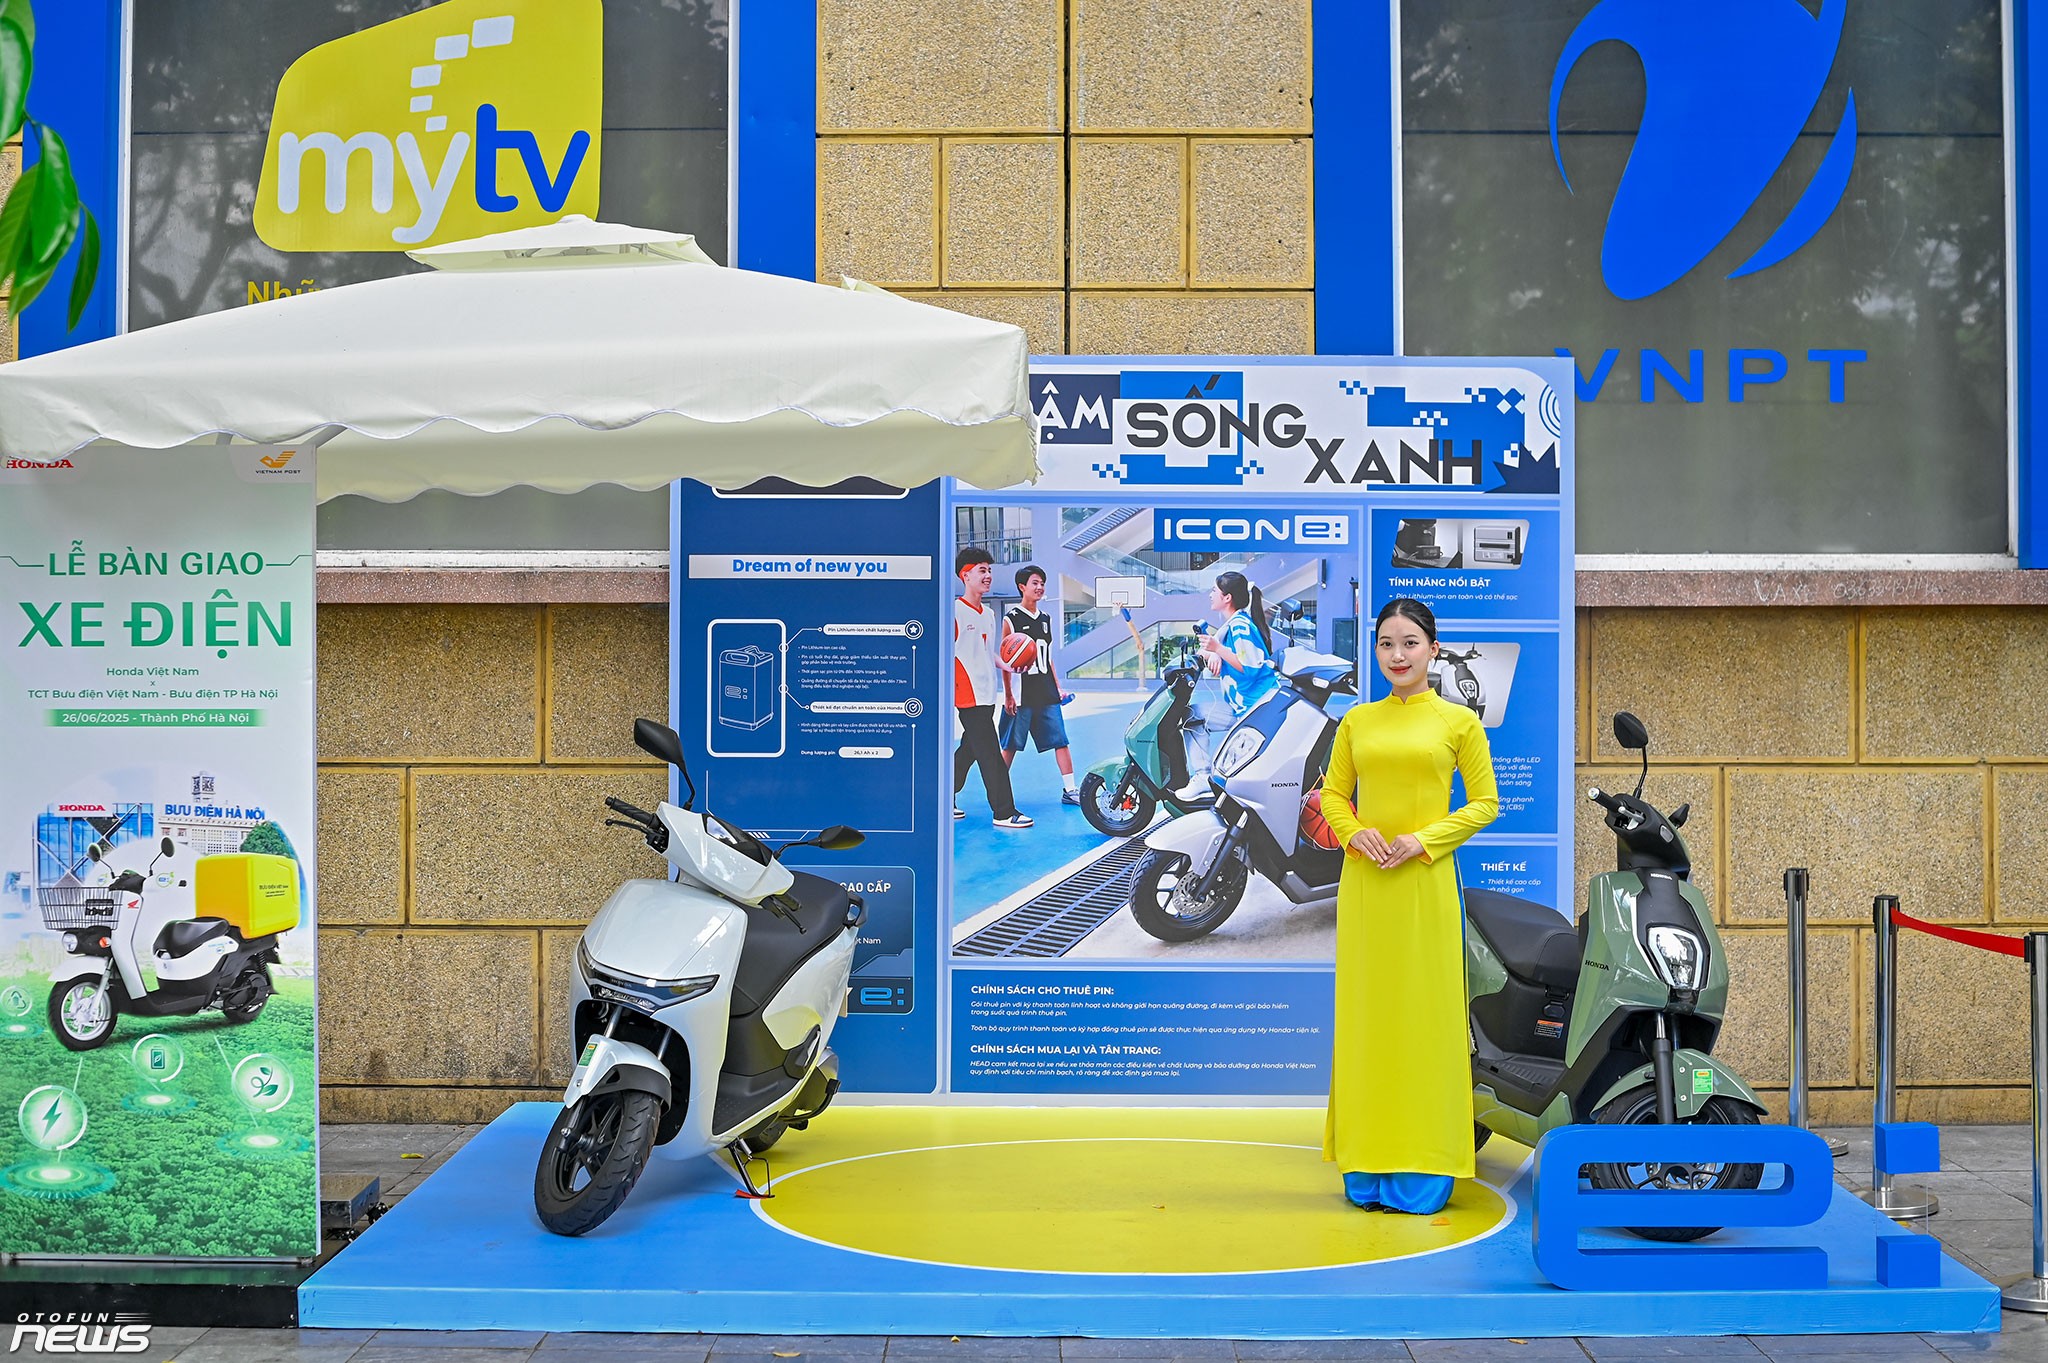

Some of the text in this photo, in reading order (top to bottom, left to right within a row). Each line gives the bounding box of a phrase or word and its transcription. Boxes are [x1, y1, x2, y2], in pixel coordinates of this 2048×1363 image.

[277, 103, 591, 244] mytv
[1553, 347, 1868, 403] VNPT
[1028, 379, 1111, 441] ẬM
[1126, 374, 1307, 449] SỐNG
[1303, 437, 1483, 485] XANH
[1163, 518, 1290, 541] ICON
[49, 539, 264, 576] LỄ BÀN GIAO
[732, 558, 888, 577] Dream of new you
[1388, 576, 1491, 589] TÍNH NĂNG NỔI BẬT
[17, 588, 292, 660] XE ĐIỆN
[106, 666, 199, 678] Honda Việt Nam
[28, 689, 50, 699] TCT
[51, 689, 76, 699] Bưu
[77, 689, 104, 701] điện
[105, 689, 129, 701] Việt
[130, 689, 159, 699] Nam
[168, 689, 192, 699] Bưu
[194, 689, 220, 701] điện
[222, 689, 238, 698] TP
[239, 689, 256, 699] Hà
[258, 689, 278, 701] Nội
[62, 711, 130, 724] 26/06/2025
[139, 712, 179, 723] Thành
[181, 712, 206, 723] Phố
[208, 712, 226, 723] Hà
[228, 712, 249, 725] Nội
[58, 803, 106, 813] HONDA
[164, 803, 266, 823] BƯU ĐIỆN HÀ NỘI
[1480, 861, 1526, 872] THIẾT KẾ
[866, 879, 892, 893] CẤP
[1584, 959, 1610, 972] HONDA
[970, 984, 1115, 995] CHÍNH SÁCH CHO THUÊ PIN:
[970, 1043, 1161, 1056] CHÍNH SÁCH MUA LẠI VÀ TÂN TRANG:
